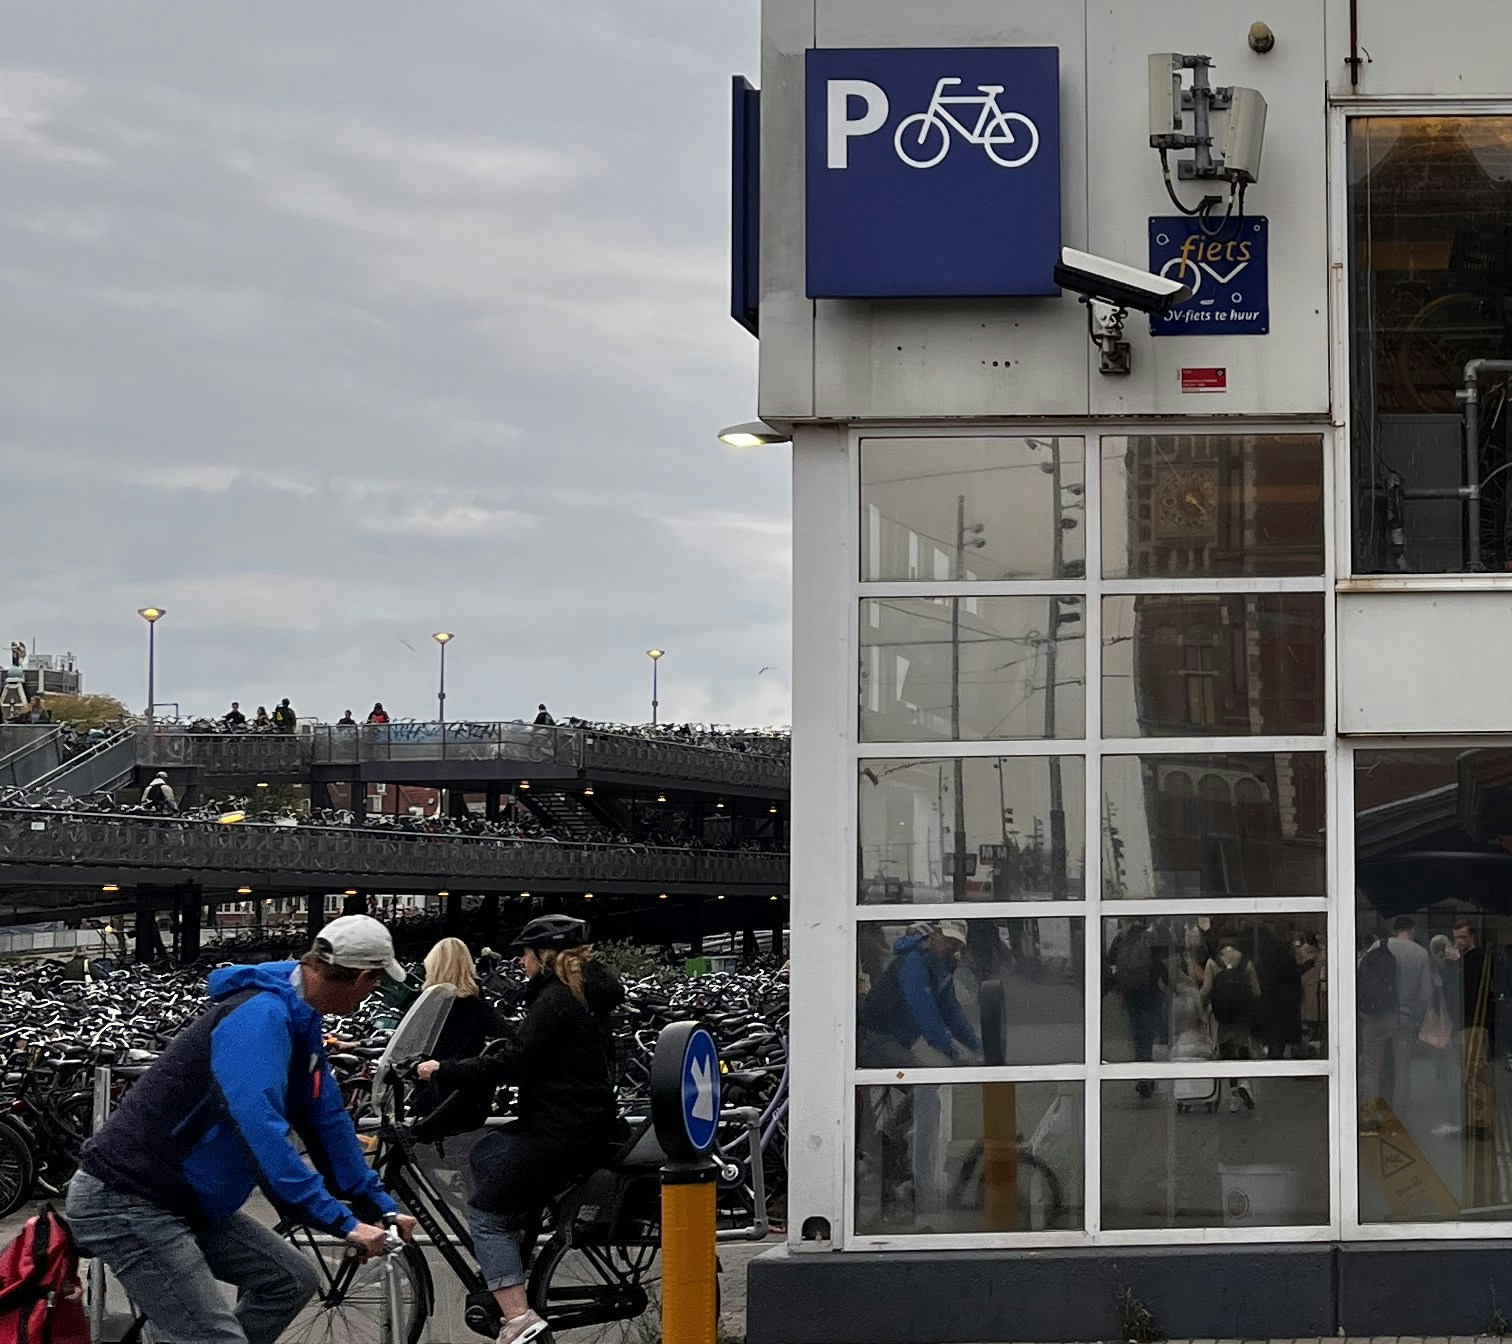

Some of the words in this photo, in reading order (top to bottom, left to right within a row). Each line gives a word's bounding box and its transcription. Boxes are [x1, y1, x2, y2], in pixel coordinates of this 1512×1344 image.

[827, 79, 889, 169] P
[1179, 234, 1252, 279] fiets
[1215, 310, 1228, 321] te
[1230, 308, 1260, 321] huur
